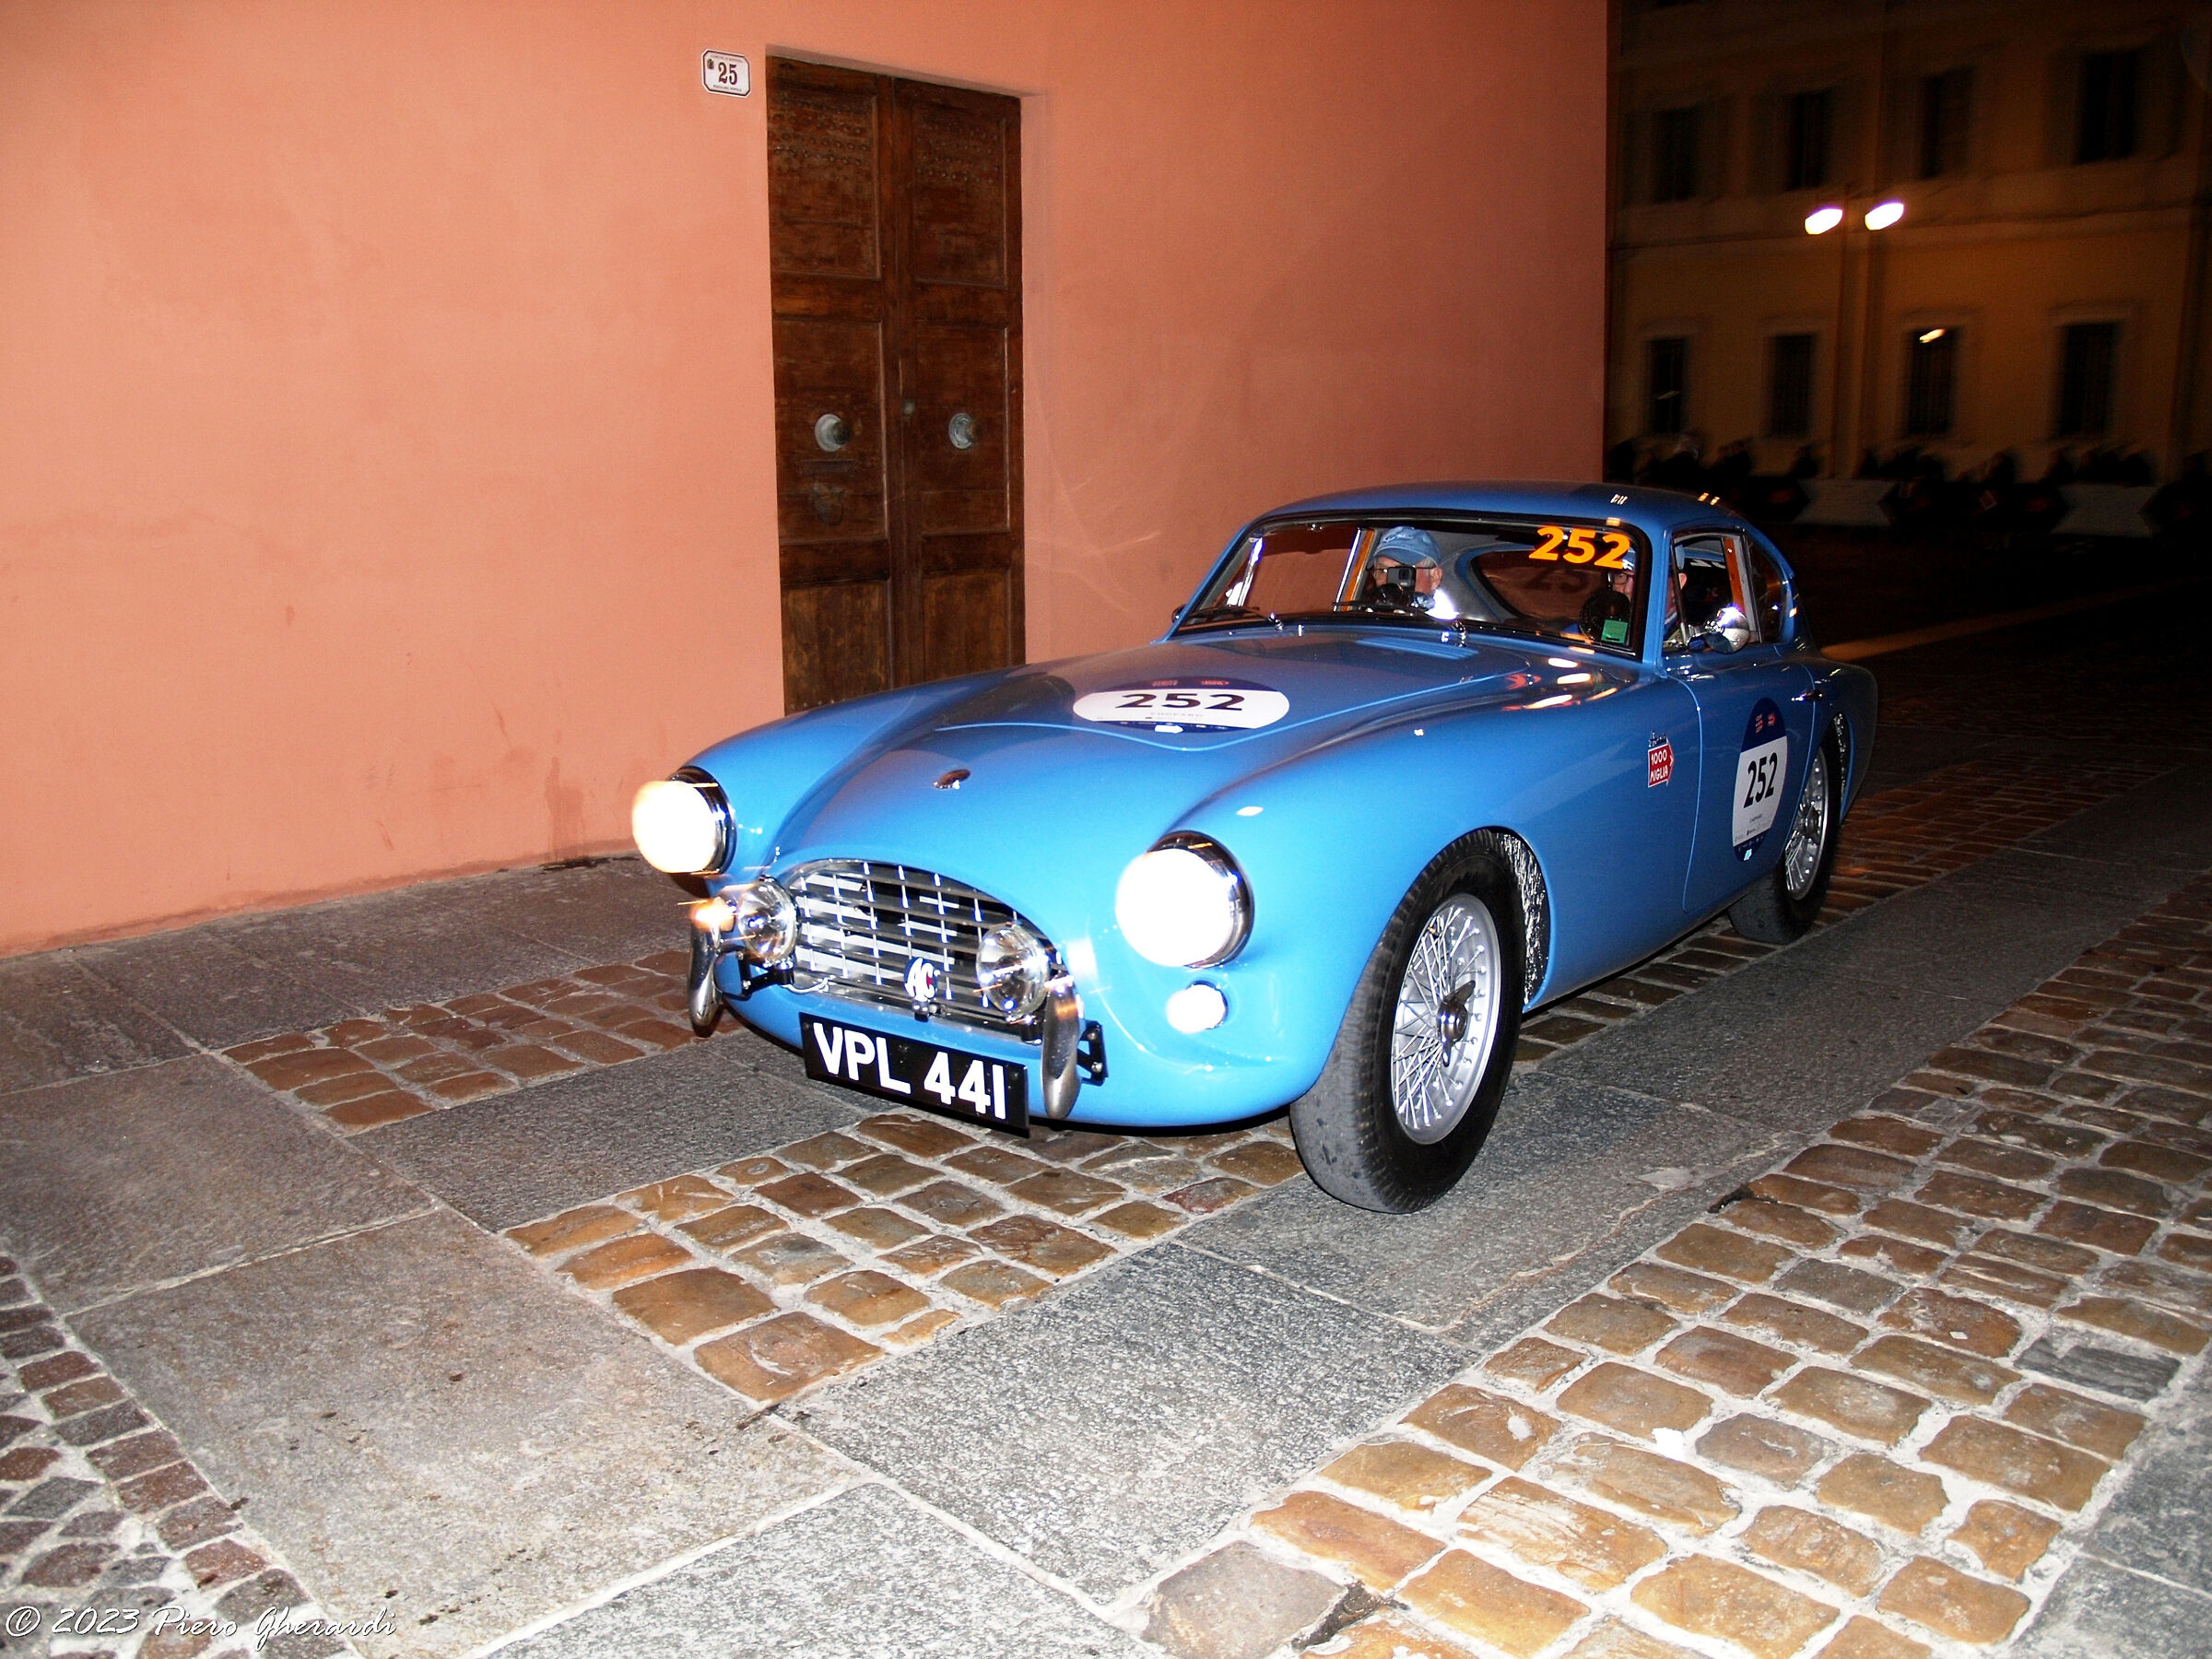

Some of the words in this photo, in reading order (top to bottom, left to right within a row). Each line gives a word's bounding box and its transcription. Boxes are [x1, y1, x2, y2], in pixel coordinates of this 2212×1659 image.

[718, 62, 737, 85] 25
[1528, 525, 1630, 570] 252
[1115, 693, 1245, 711] 252
[1651, 749, 1667, 766] 1000
[1744, 752, 1778, 808] 252
[905, 959, 935, 999] AC
[813, 1022, 912, 1094] VPL
[924, 1052, 1006, 1120] 441
